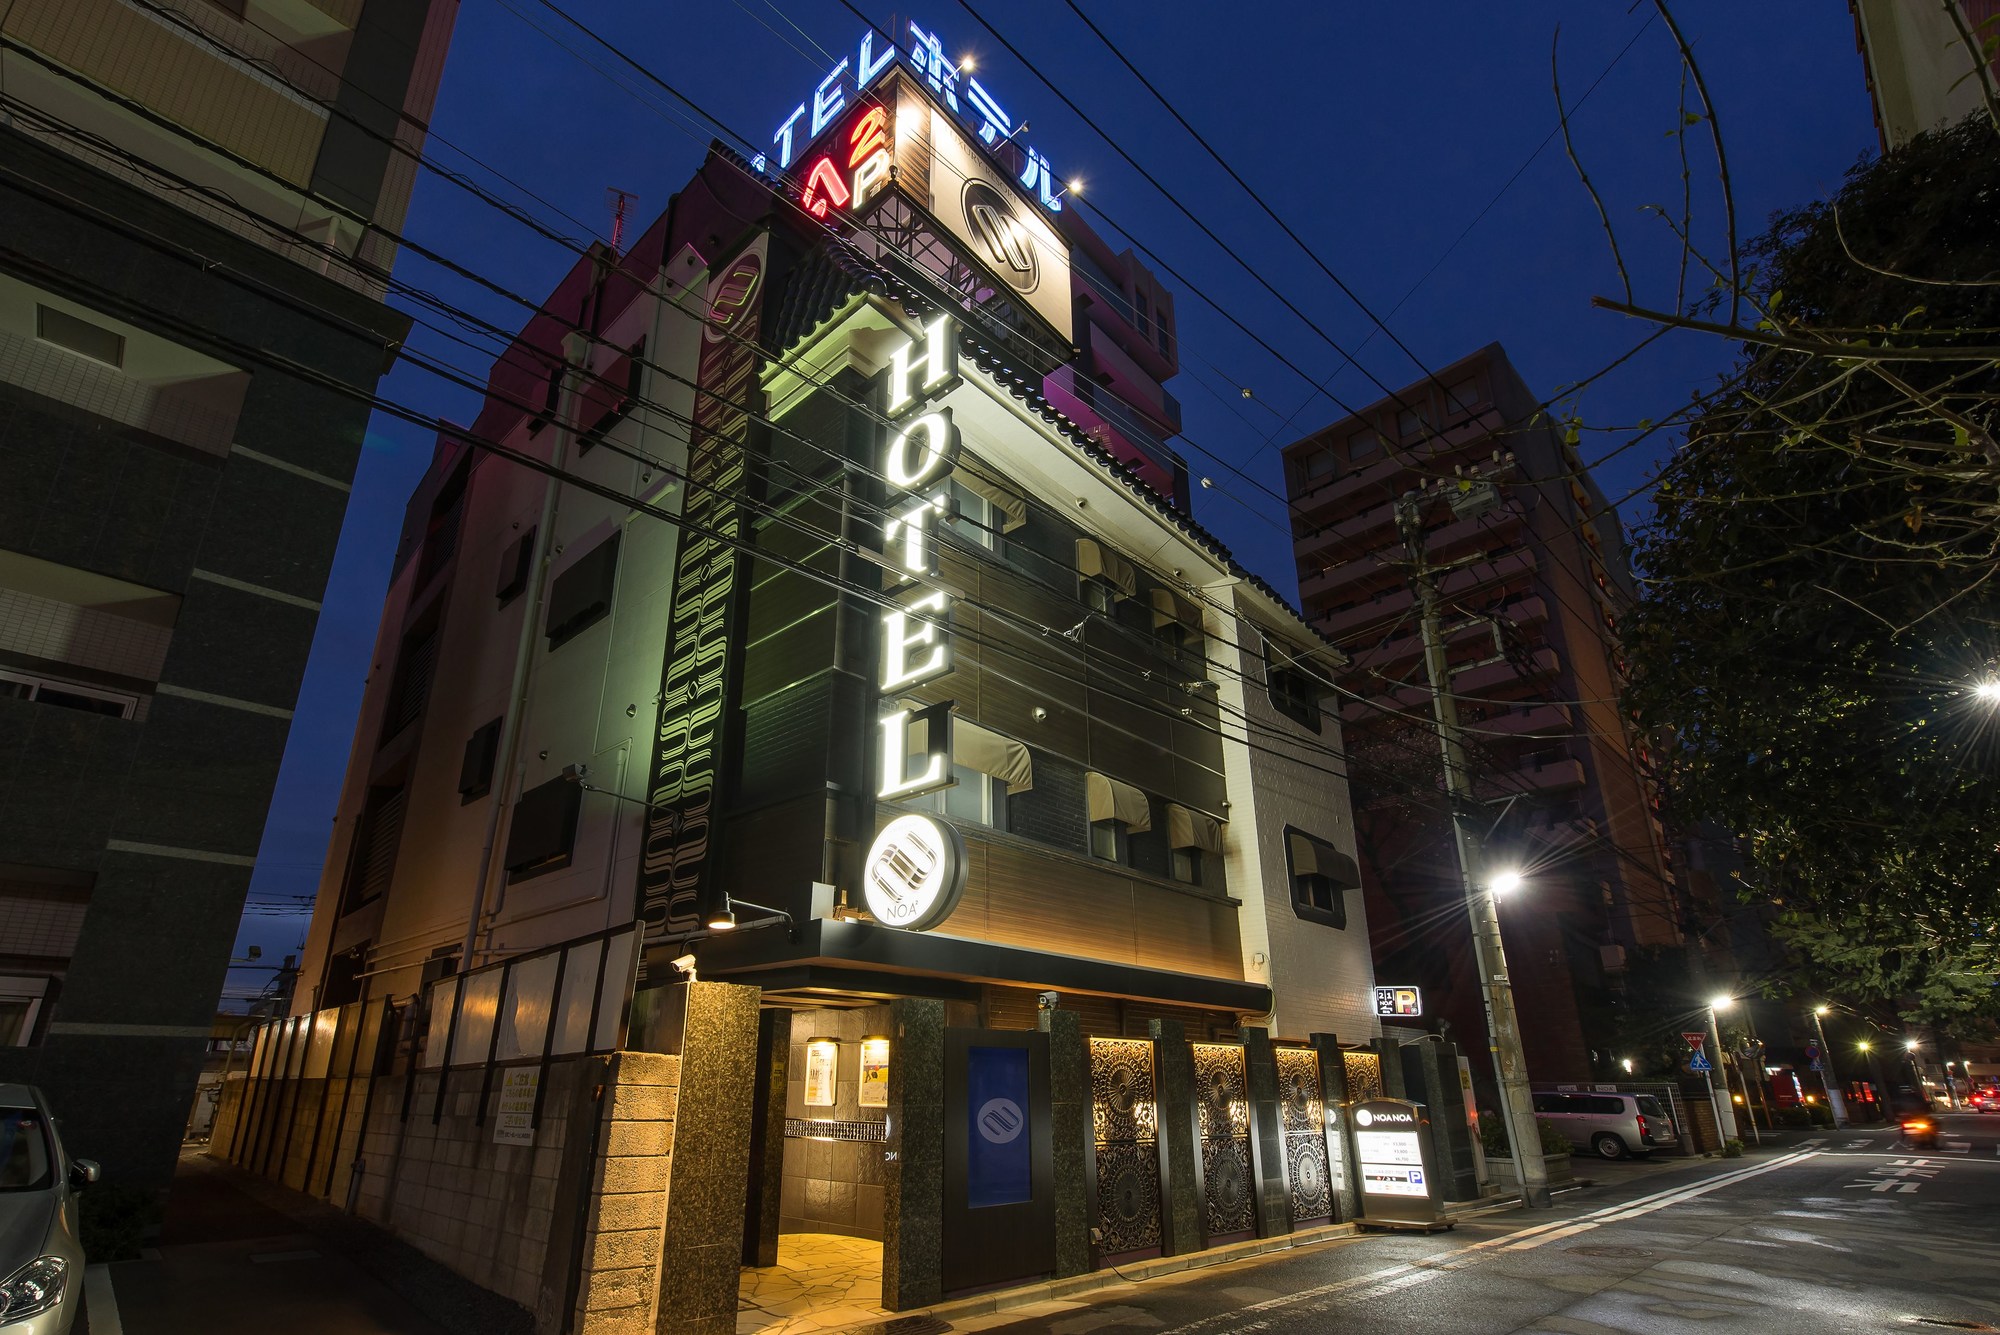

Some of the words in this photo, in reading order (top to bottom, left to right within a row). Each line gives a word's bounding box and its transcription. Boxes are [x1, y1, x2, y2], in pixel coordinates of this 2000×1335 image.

[751, 28, 896, 173] TEL
[909, 19, 1062, 213] ホテル
[985, 166, 1018, 204] RESORT
[880, 312, 952, 802] HOTEL
[1396, 990, 1416, 1014] P
[1411, 1171, 1421, 1183] P
[1843, 1159, 1950, 1193] 止まれ
